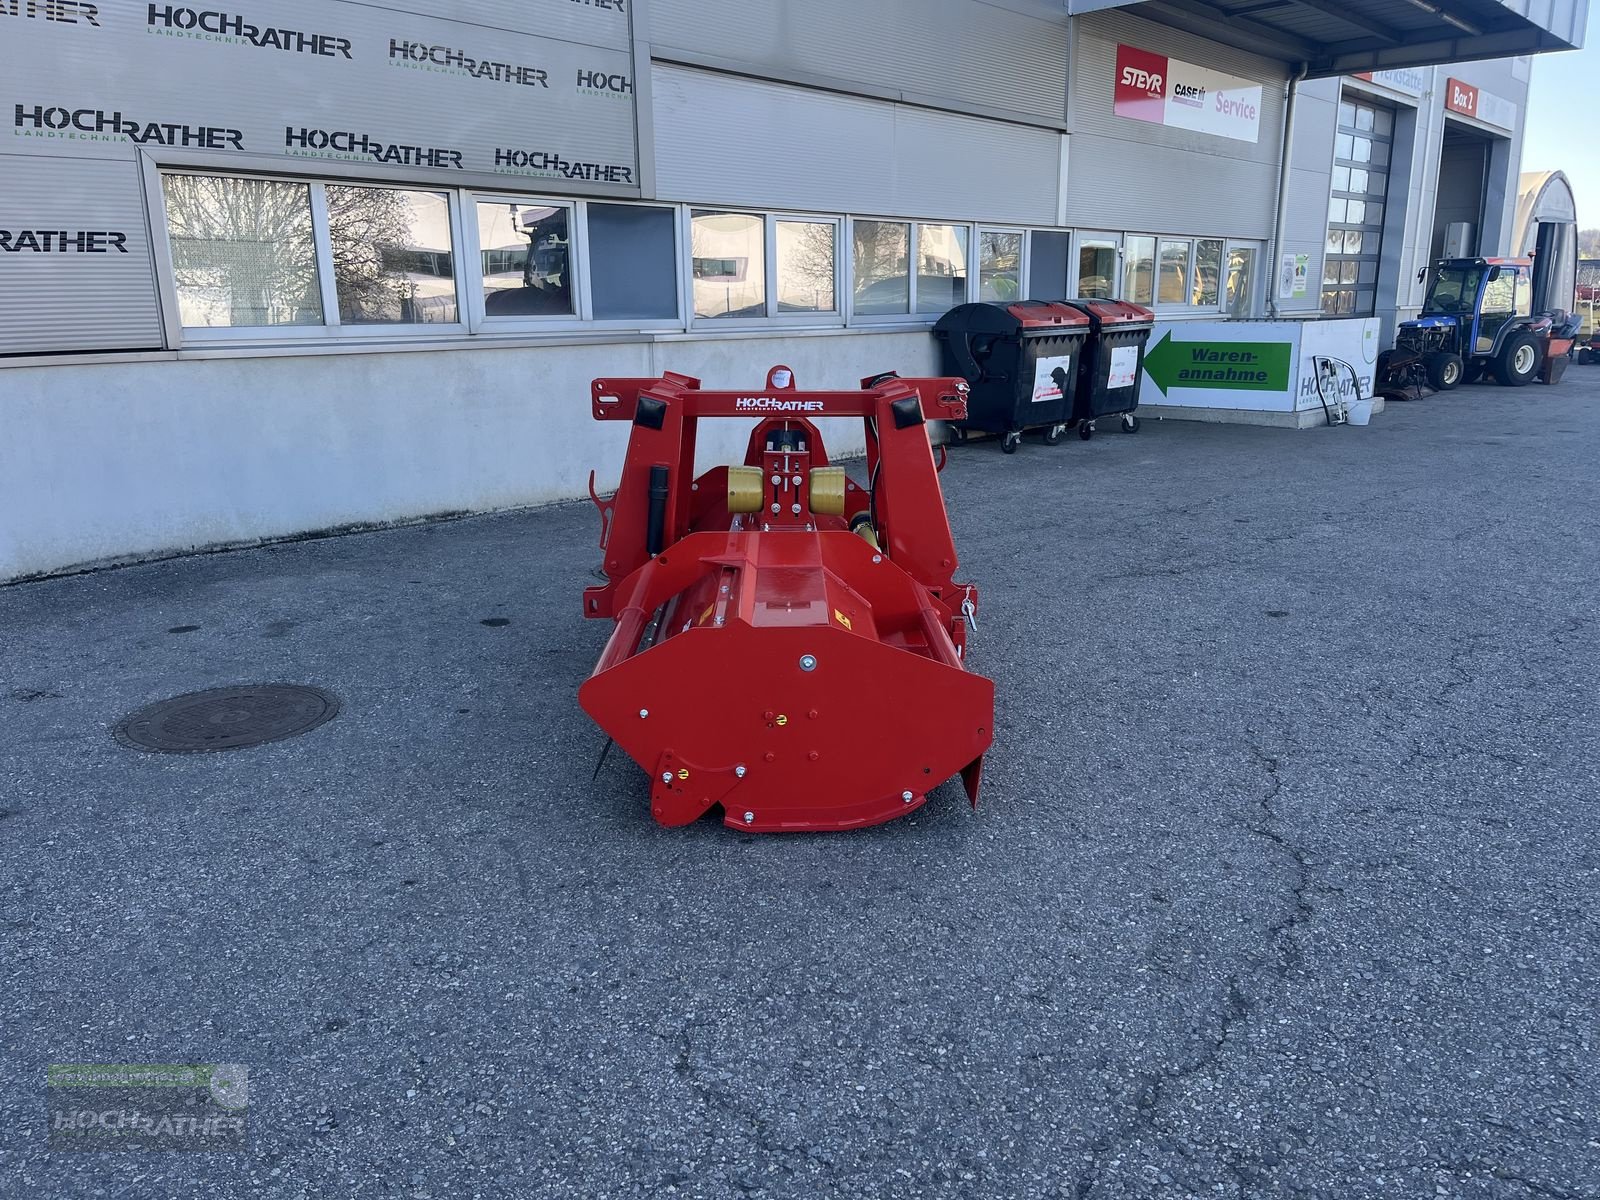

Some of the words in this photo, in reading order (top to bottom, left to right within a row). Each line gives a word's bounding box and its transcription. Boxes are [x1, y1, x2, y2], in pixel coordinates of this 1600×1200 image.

[147, 3, 353, 59] HOCHRATHER
[147, 27, 248, 46] LANDTECHNIK
[388, 60, 468, 77] LANDTECHNIK
[389, 38, 549, 88] HOCHRATHER
[1121, 66, 1162, 93] STEYR
[1174, 83, 1198, 99] CASE
[1453, 86, 1467, 107] Box
[1467, 91, 1473, 110] 2
[1216, 90, 1255, 120] Service
[14, 104, 245, 150] HOCHRATHER
[14, 129, 128, 143] LANDTECHNIK
[284, 149, 374, 162] LANDTECHNIK
[286, 126, 464, 169] HOCHRATHER
[495, 148, 632, 183] HOCHRATHER
[1192, 348, 1258, 362] Waren-
[1178, 368, 1268, 382] annahme
[736, 397, 824, 411] HOCHRATHER
